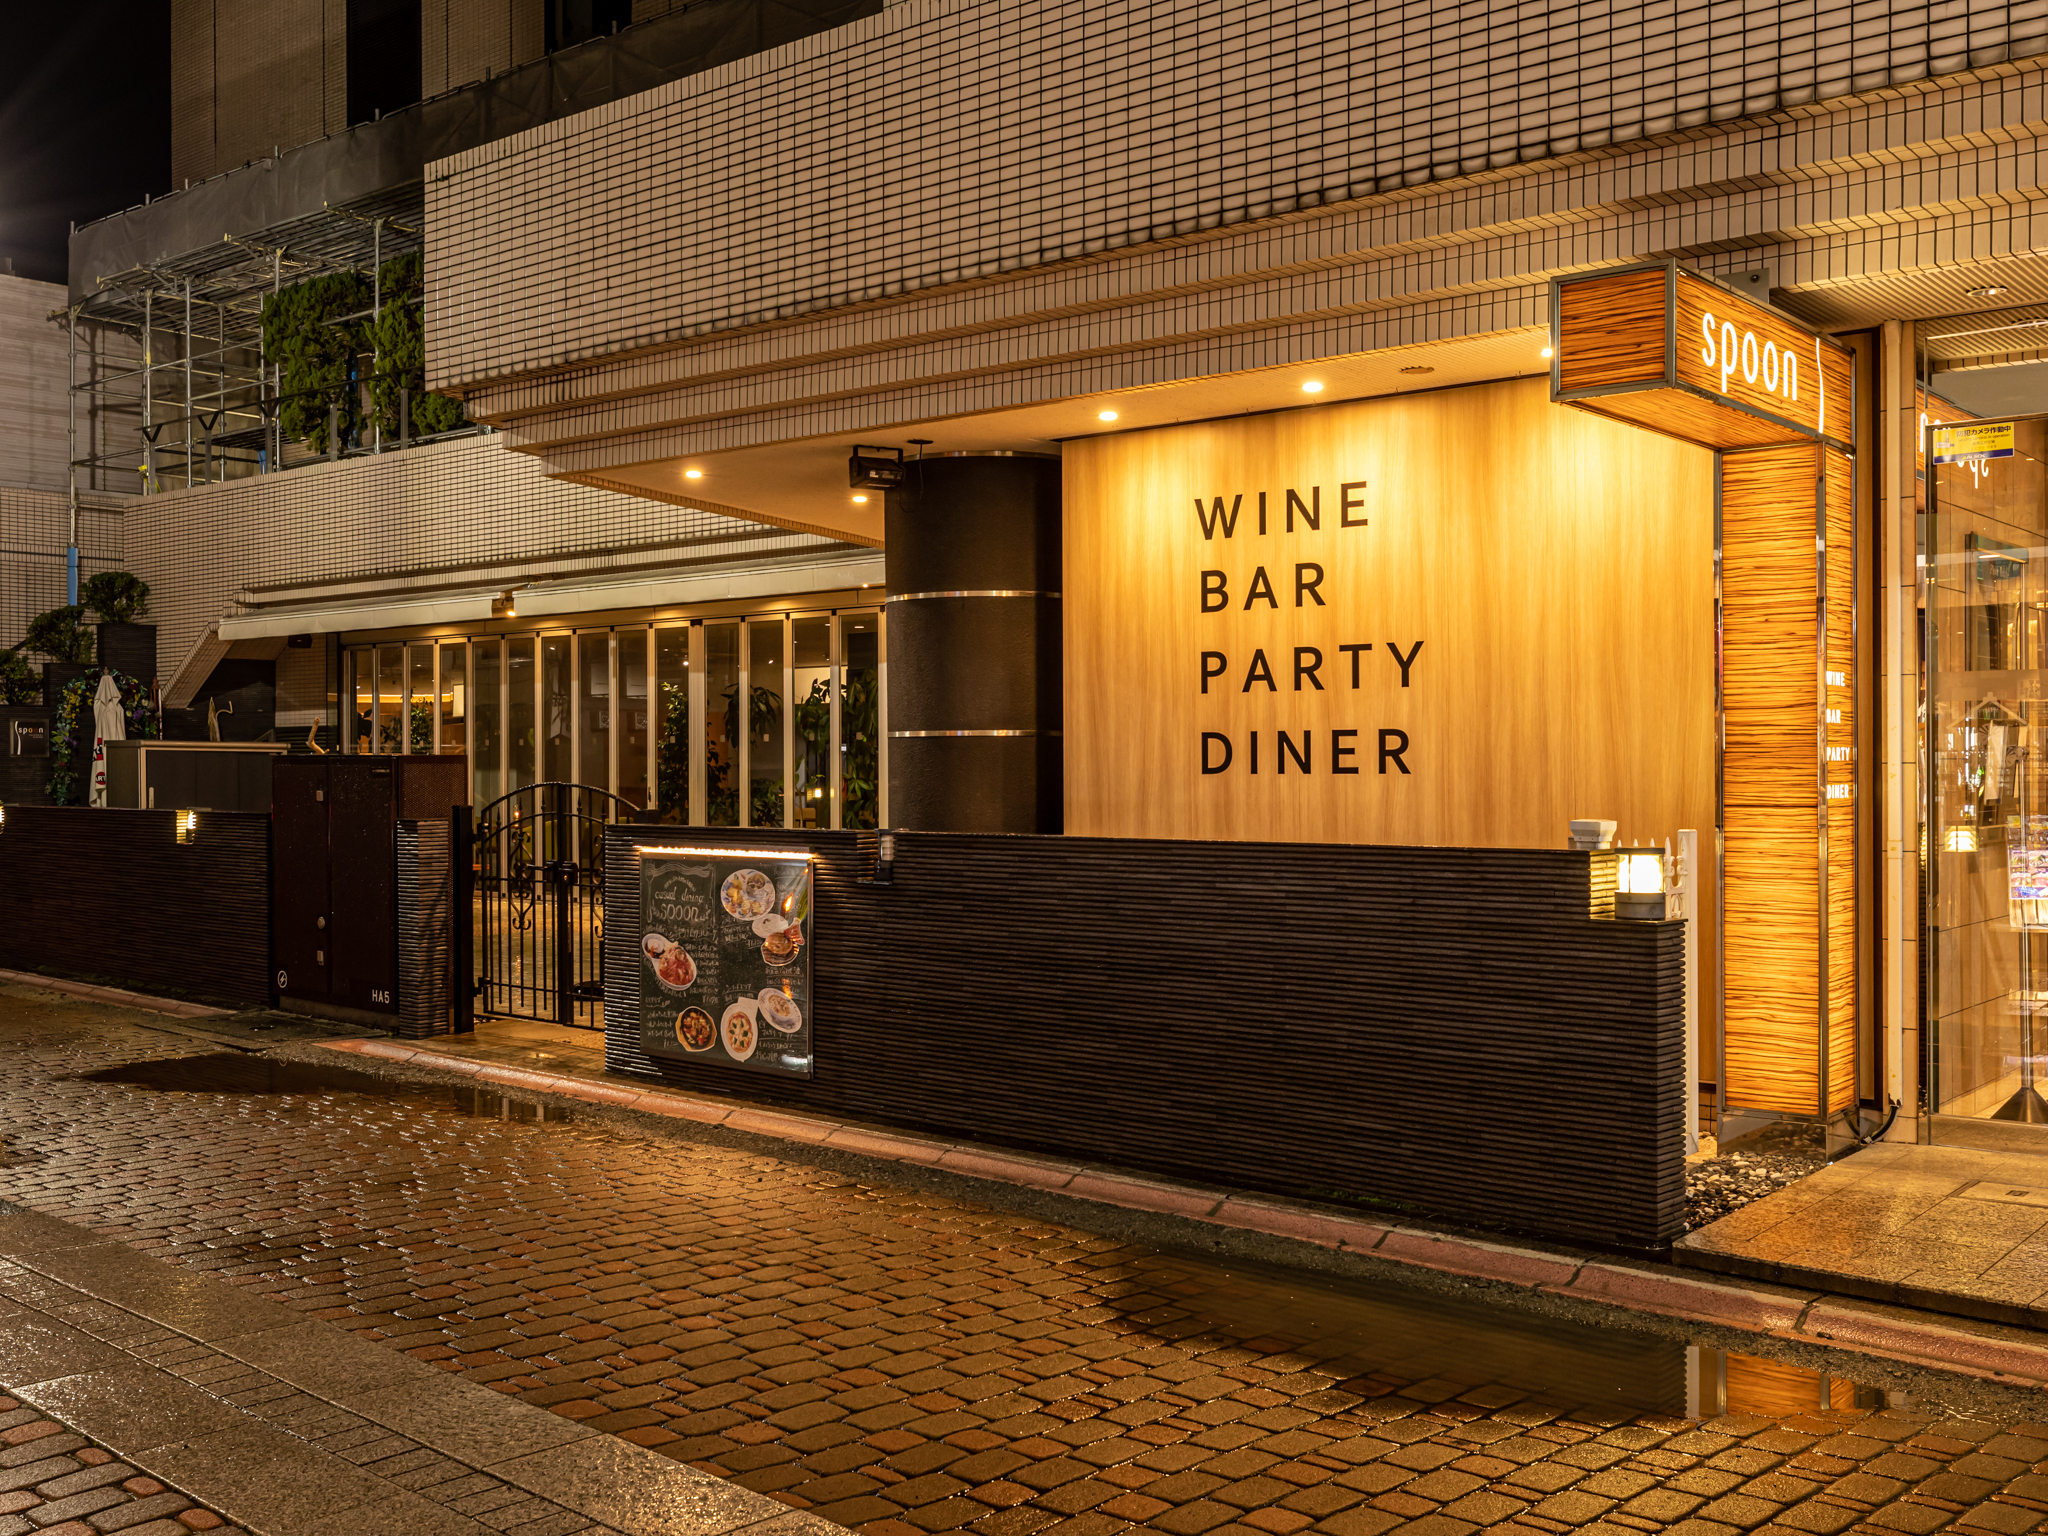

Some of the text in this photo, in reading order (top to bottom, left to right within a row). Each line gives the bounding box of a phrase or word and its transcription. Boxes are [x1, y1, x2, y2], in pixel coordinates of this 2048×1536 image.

[1702, 312, 1797, 401] spoon
[1956, 425, 2011, 437] 防犯カメラ作動中
[1194, 480, 1368, 540] WINE
[1200, 562, 1326, 613] BAR
[1200, 640, 1425, 694] PARTY
[1826, 671, 1845, 687] WINE
[1826, 709, 1841, 724] BAR
[18, 727, 44, 735] spoon
[1201, 728, 1411, 775] DINER
[1826, 747, 1850, 761] PARTY
[1827, 784, 1849, 799] DINER
[372, 989, 390, 1004] HA5
